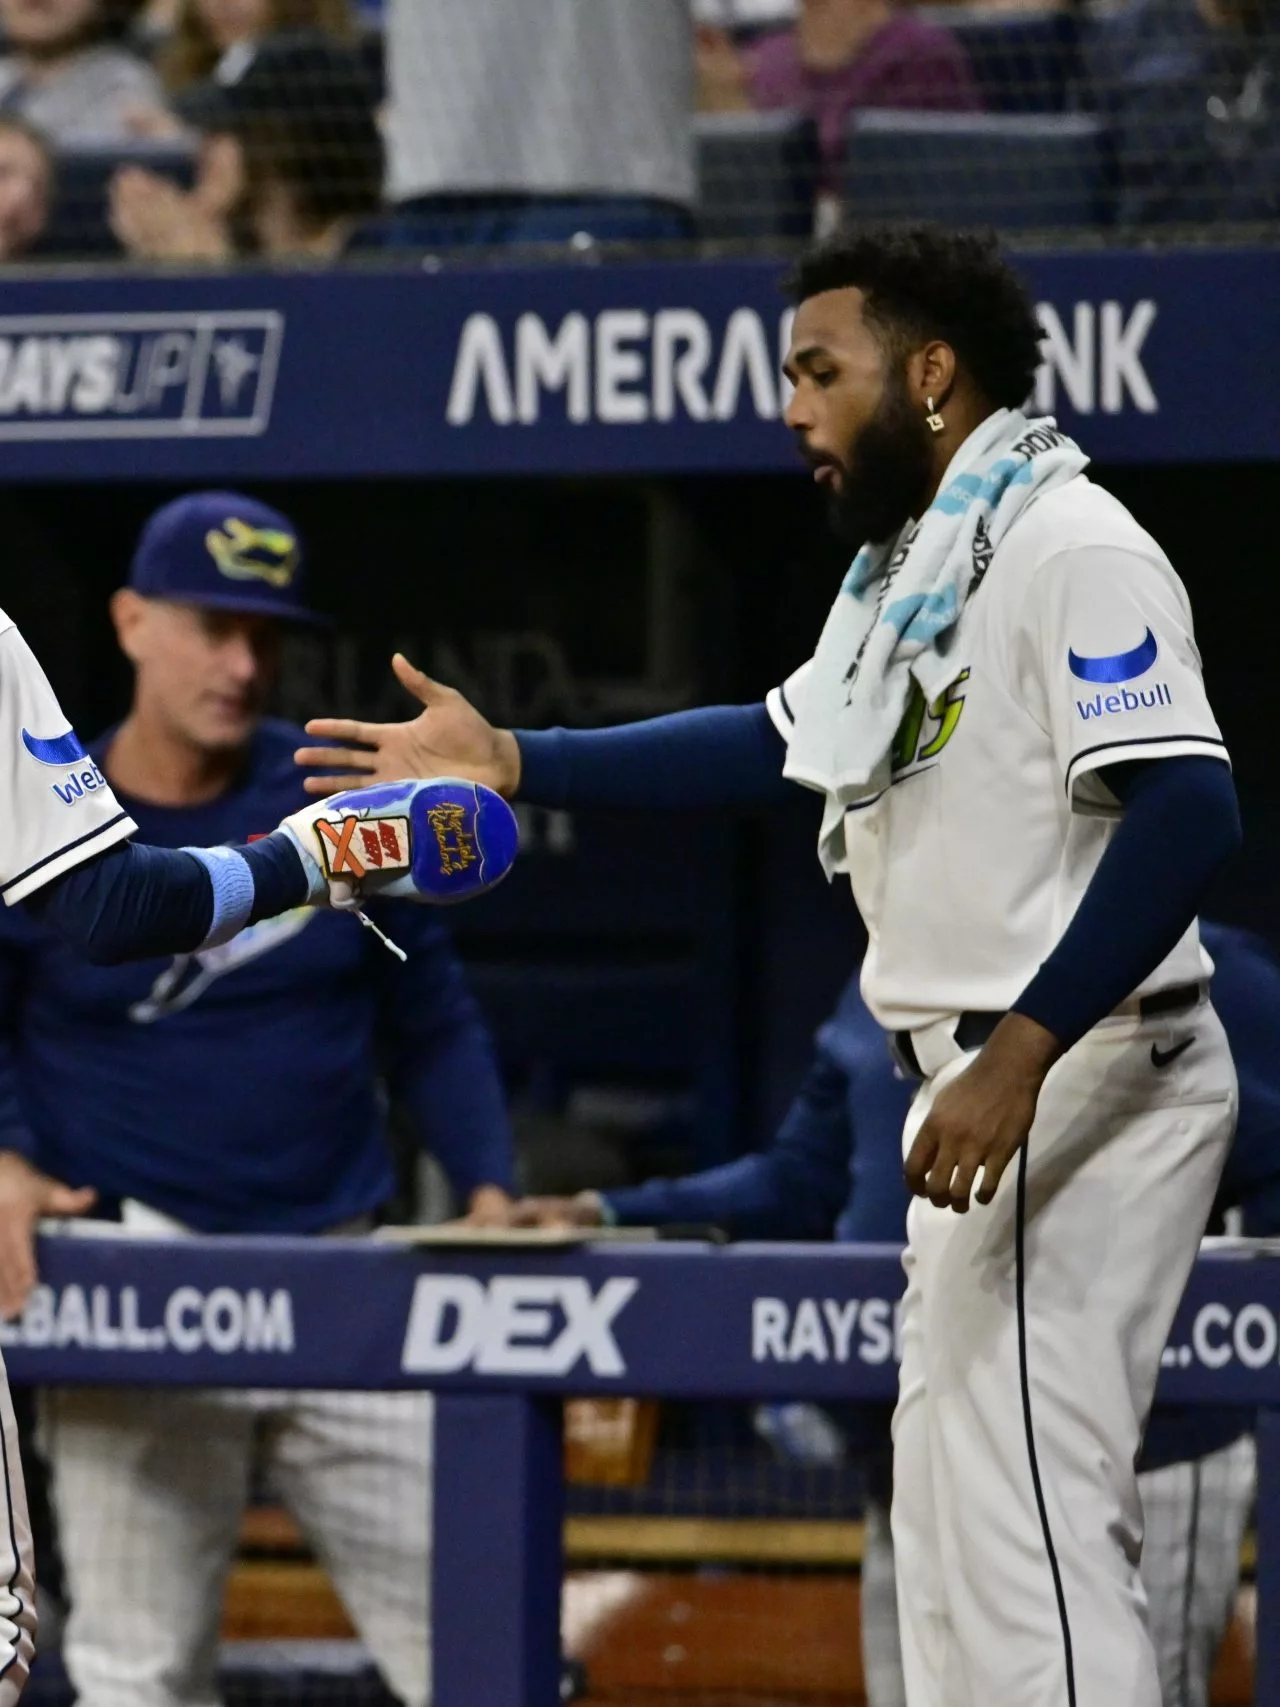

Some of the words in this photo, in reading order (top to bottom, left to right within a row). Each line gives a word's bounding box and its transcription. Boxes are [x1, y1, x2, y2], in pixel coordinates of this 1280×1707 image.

[447, 308, 795, 427] AMERA
[1075, 683, 1173, 721] Webull
[401, 1273, 640, 1378] DEX
[752, 1297, 901, 1365] RAYS
